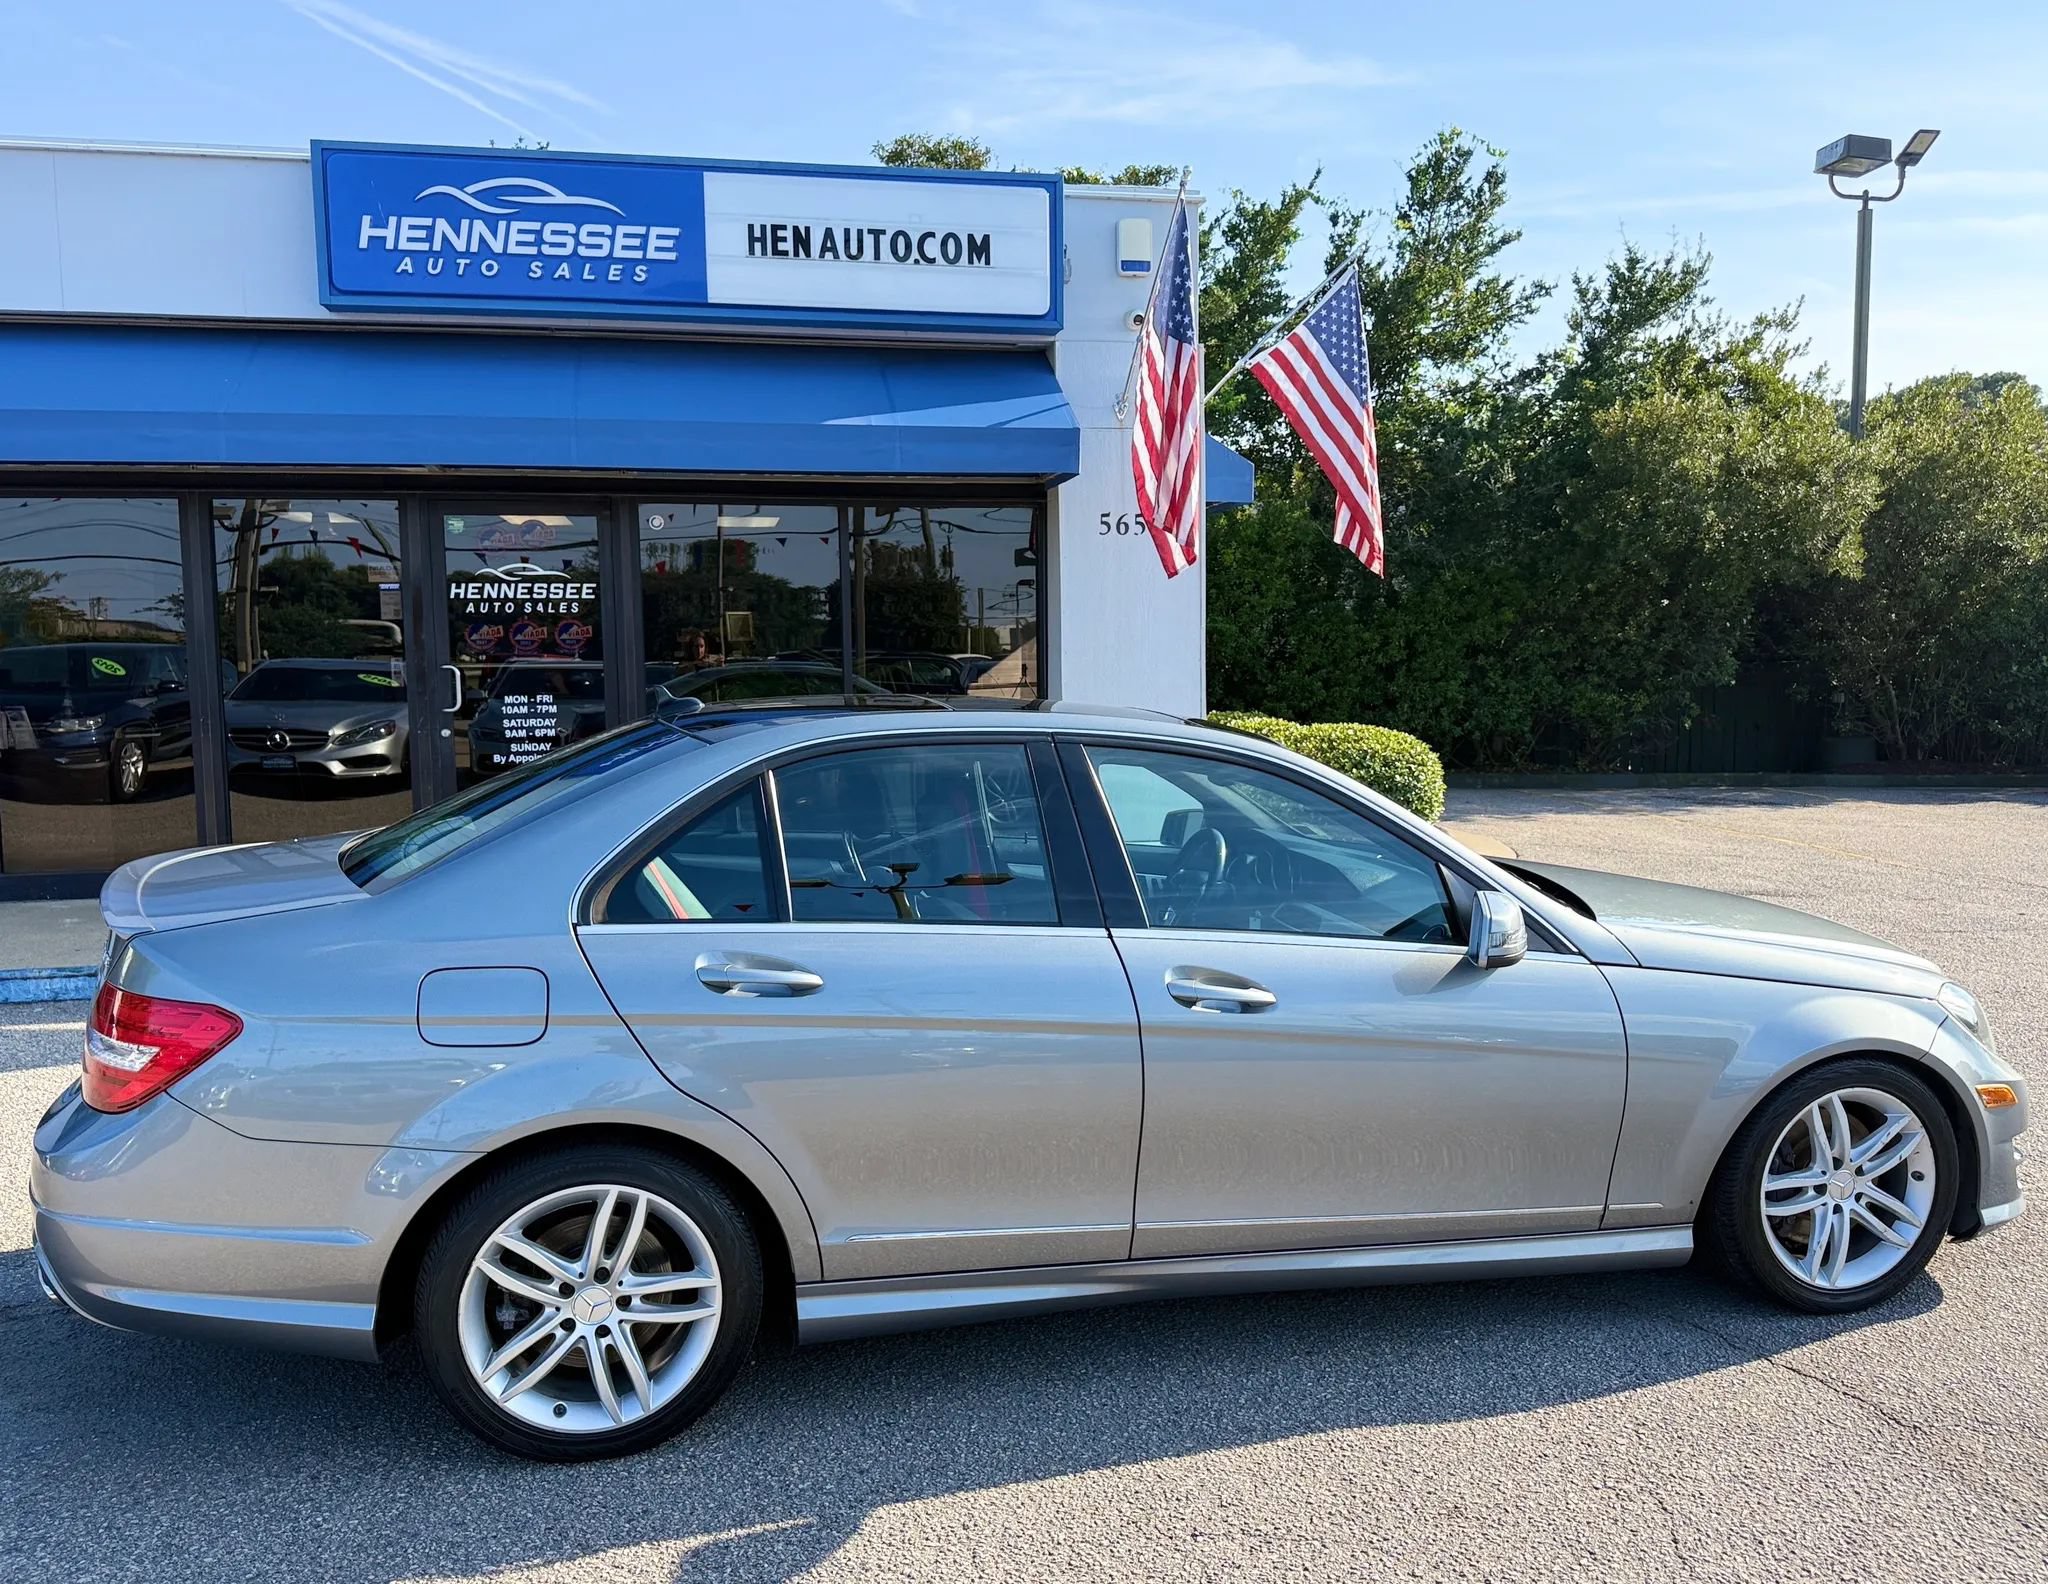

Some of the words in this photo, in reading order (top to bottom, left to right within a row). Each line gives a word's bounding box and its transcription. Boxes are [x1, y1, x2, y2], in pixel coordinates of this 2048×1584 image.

[358, 214, 682, 261] HENNESSEE
[396, 256, 500, 277] AUTO
[528, 261, 649, 282] SALES
[450, 582, 597, 599] HENNESSEE
[466, 602, 515, 613] AUTO
[524, 602, 580, 613] SALES
[504, 695, 528, 704] MON
[536, 694, 553, 703] FRI
[501, 705, 528, 714] 10AM
[536, 704, 557, 713] 7PM
[503, 718, 557, 728] SATURDAY
[504, 729, 527, 738] 9AM
[534, 728, 556, 737] 6PM
[510, 742, 552, 752] SUNDAY
[493, 754, 507, 764] By
[508, 753, 546, 764] Appoi
